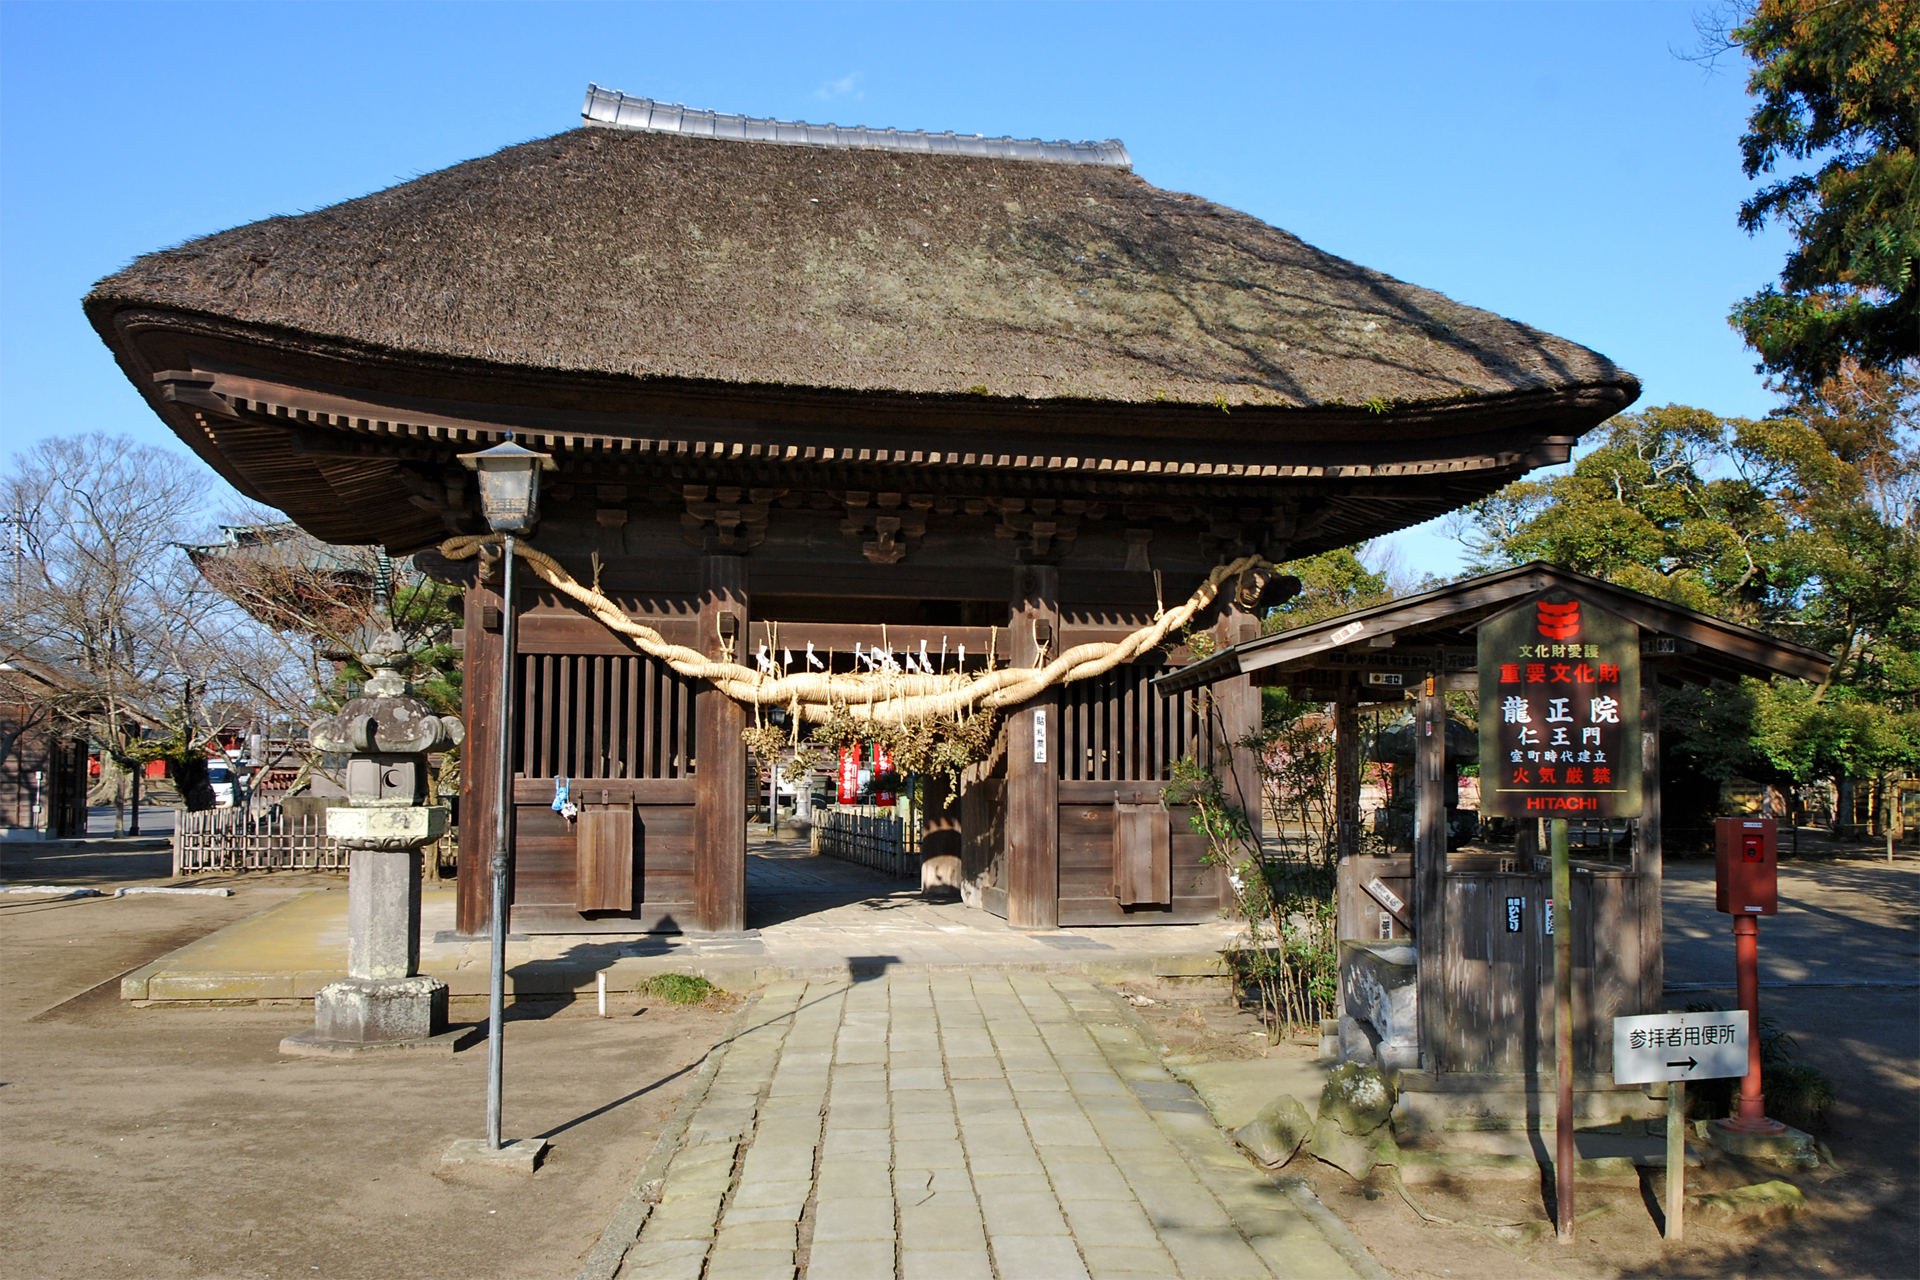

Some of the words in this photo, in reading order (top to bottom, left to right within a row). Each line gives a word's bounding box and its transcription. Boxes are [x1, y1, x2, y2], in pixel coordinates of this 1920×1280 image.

[1519, 644, 1599, 659] 文化財愛護
[1500, 663, 1620, 683] 重要文化財
[1501, 695, 1620, 724] 龍正院
[1036, 715, 1045, 760] 貼札禁止
[1518, 726, 1601, 746] 仁王門
[1510, 749, 1607, 763] 室町時代建立
[1513, 766, 1611, 784] 火気厳禁
[1526, 797, 1597, 810] HITACHI
[1629, 1023, 1736, 1049] 参拝者用便所
